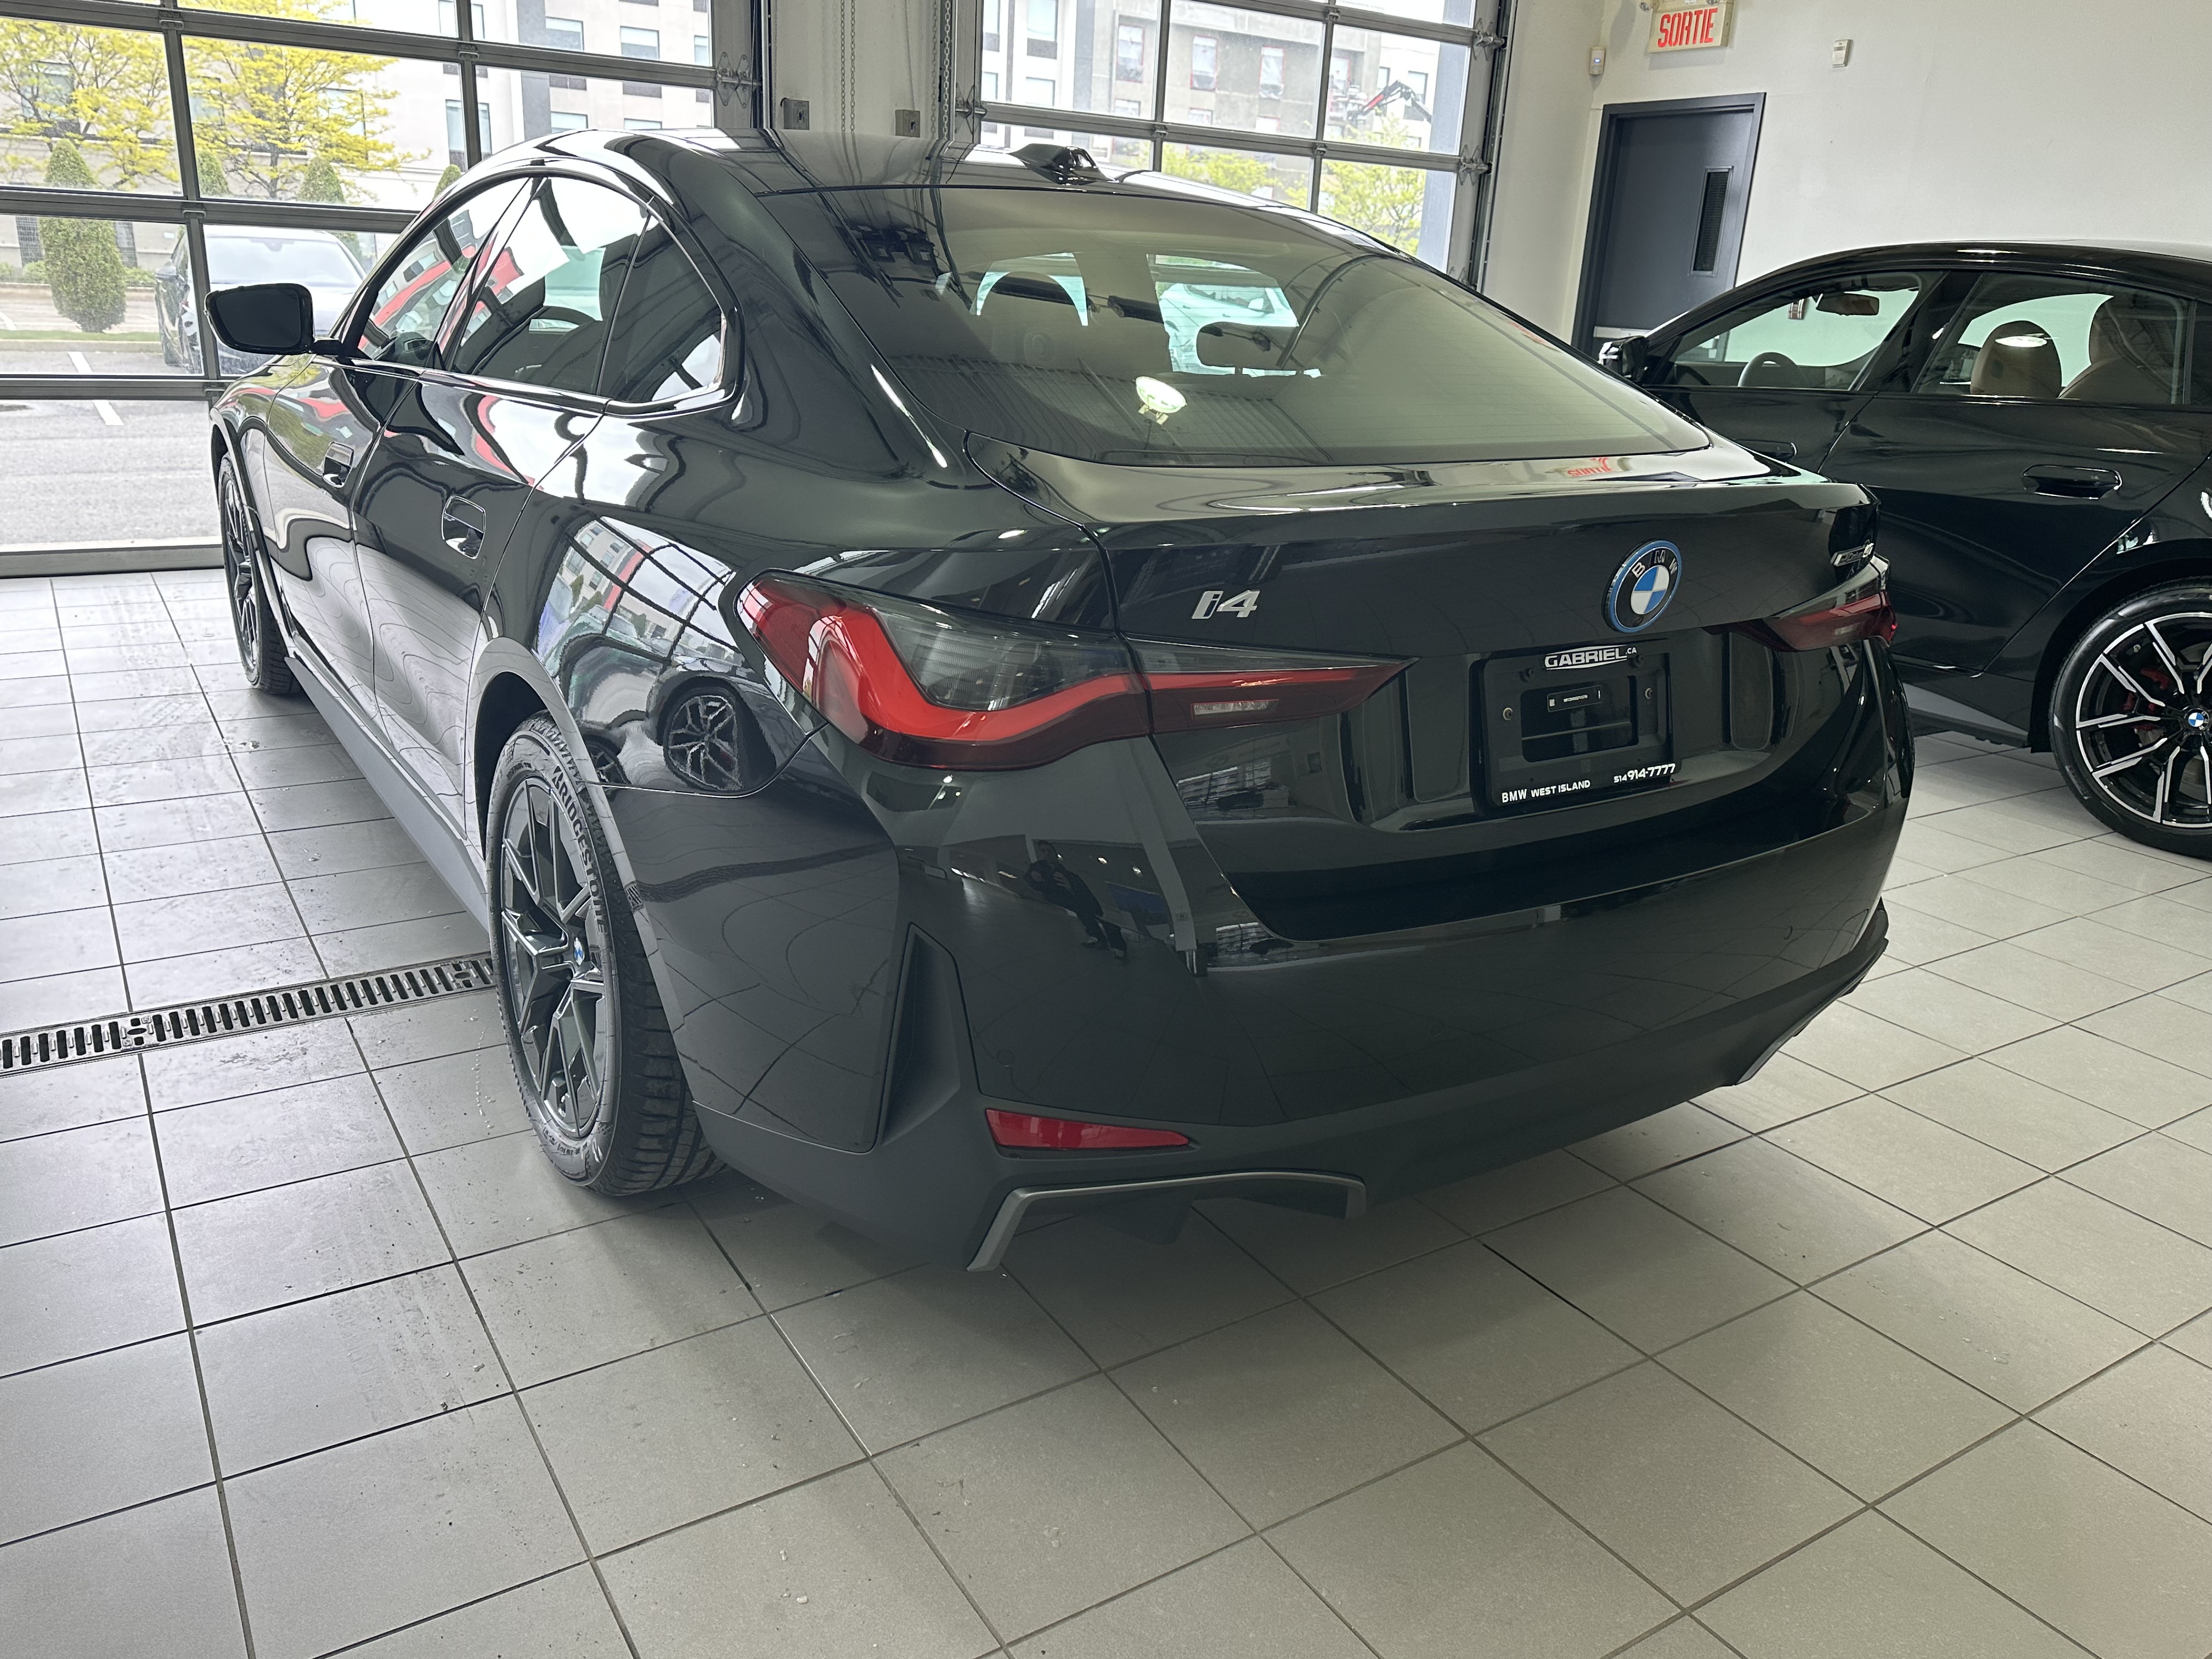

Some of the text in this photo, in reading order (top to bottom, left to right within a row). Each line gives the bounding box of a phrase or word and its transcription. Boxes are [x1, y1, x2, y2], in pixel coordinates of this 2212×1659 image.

[1657, 8, 1718, 48] SORTIE
[1631, 550, 1678, 578] BMW
[1192, 590, 1260, 619] i4
[1502, 780, 1590, 803] BMW WEST ISLAND
[552, 765, 605, 934] BRIDGESTONE
